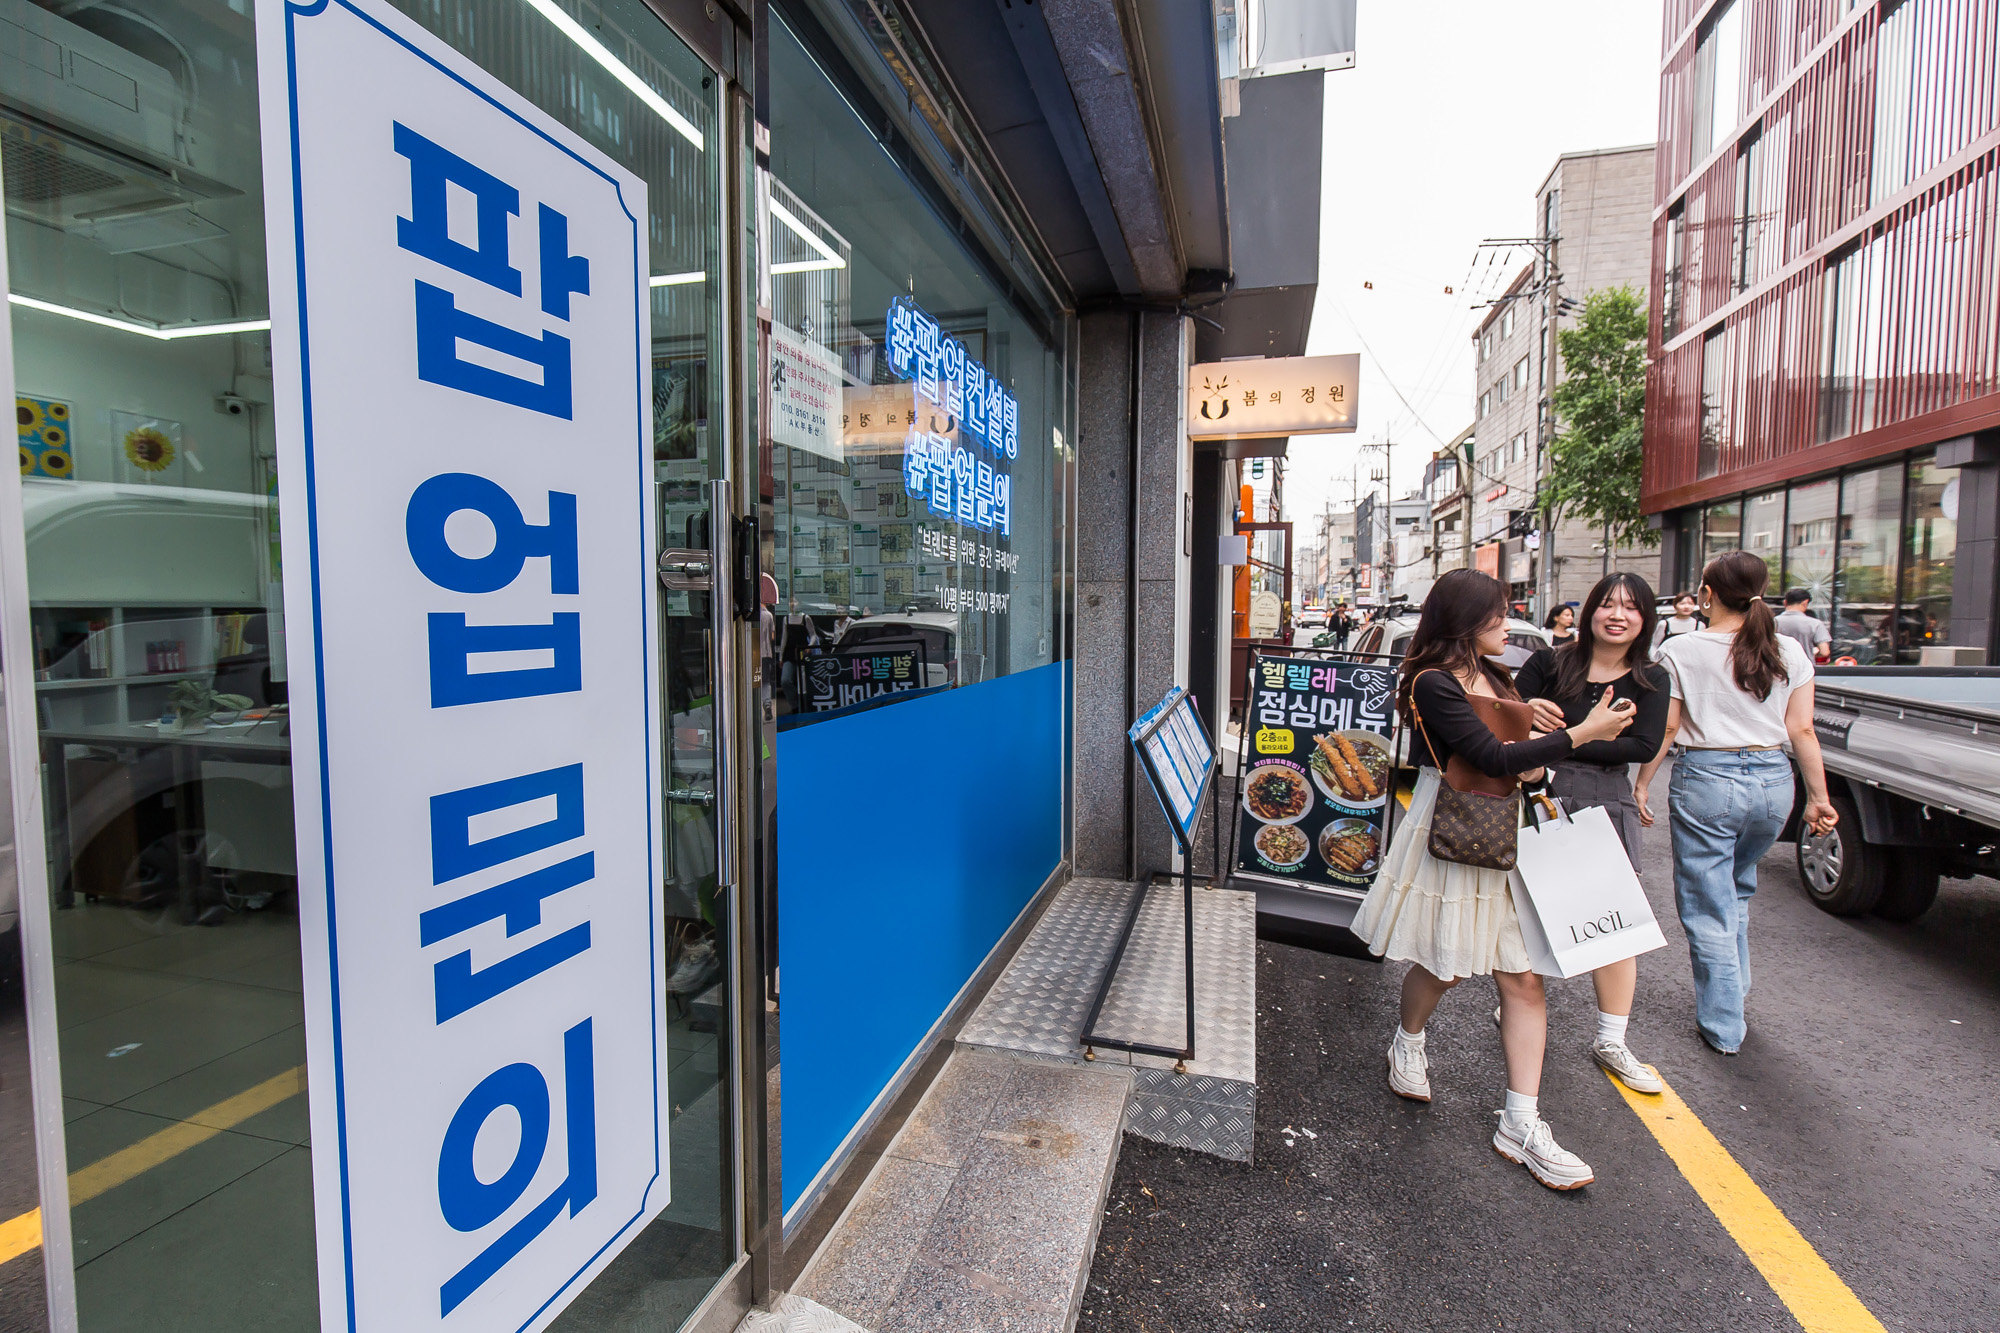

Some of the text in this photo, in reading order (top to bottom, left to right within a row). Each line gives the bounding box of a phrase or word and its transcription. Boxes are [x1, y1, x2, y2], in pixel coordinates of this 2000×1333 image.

[775, 338, 790, 356] 잠깐
[790, 344, 804, 364] 외출
[785, 365, 798, 380] 전화
[798, 371, 816, 389] 주시면
[892, 304, 1018, 460] #팝업컨설팅
[789, 386, 802, 401] 달려
[909, 430, 1010, 536] #팝업문의
[961, 539, 976, 565] 위한
[979, 544, 993, 569] 공간
[960, 588, 974, 613] 부터
[975, 591, 988, 612] 500
[1261, 661, 1337, 694] 헬렐레
[393, 120, 595, 1320] 팝업문의
[1258, 690, 1388, 734] 점심메뉴
[1261, 732, 1288, 743] 2층으로
